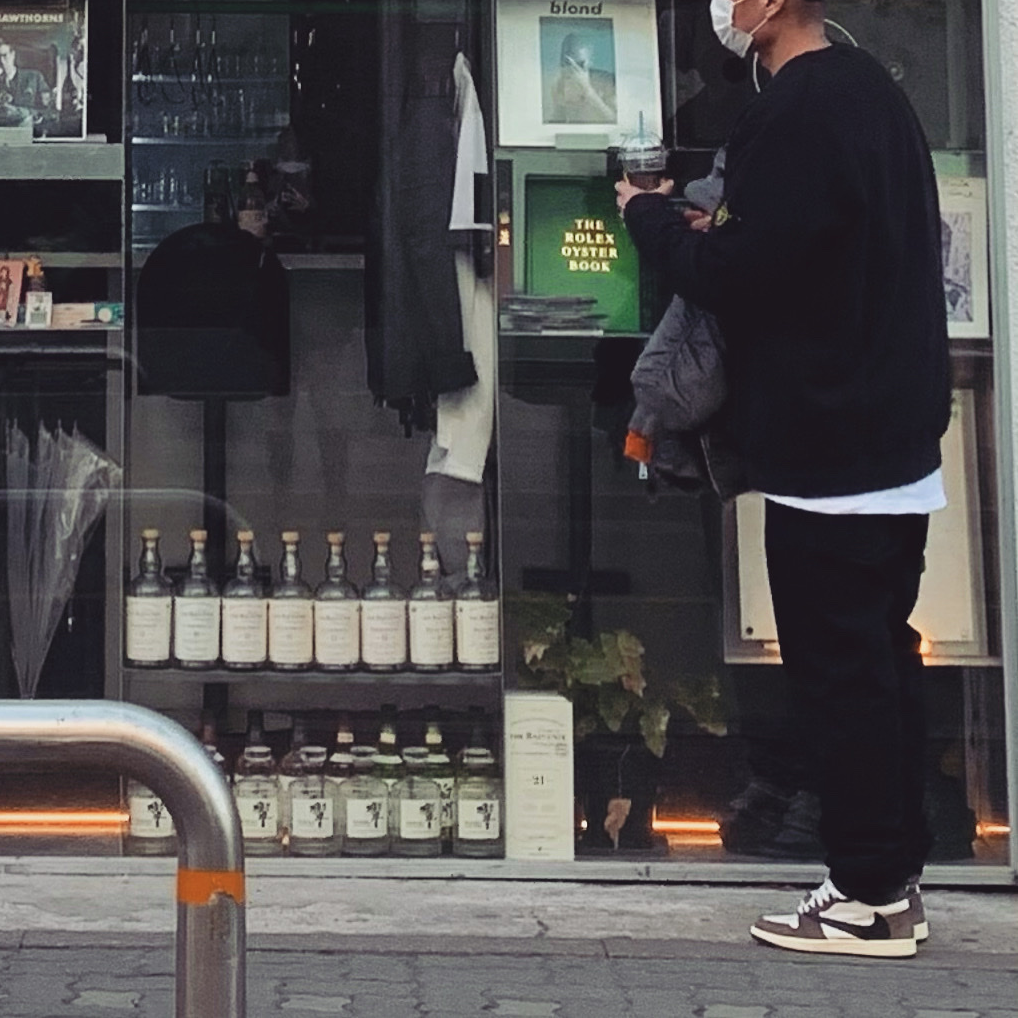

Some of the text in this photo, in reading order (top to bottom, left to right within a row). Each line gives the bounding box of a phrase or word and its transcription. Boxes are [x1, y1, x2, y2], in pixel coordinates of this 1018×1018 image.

[549, 0, 603, 15] blond
[574, 218, 605, 230] THE
[564, 232, 615, 244] ROLEX
[561, 246, 619, 259] OYSTER
[569, 260, 611, 273] BOOK
